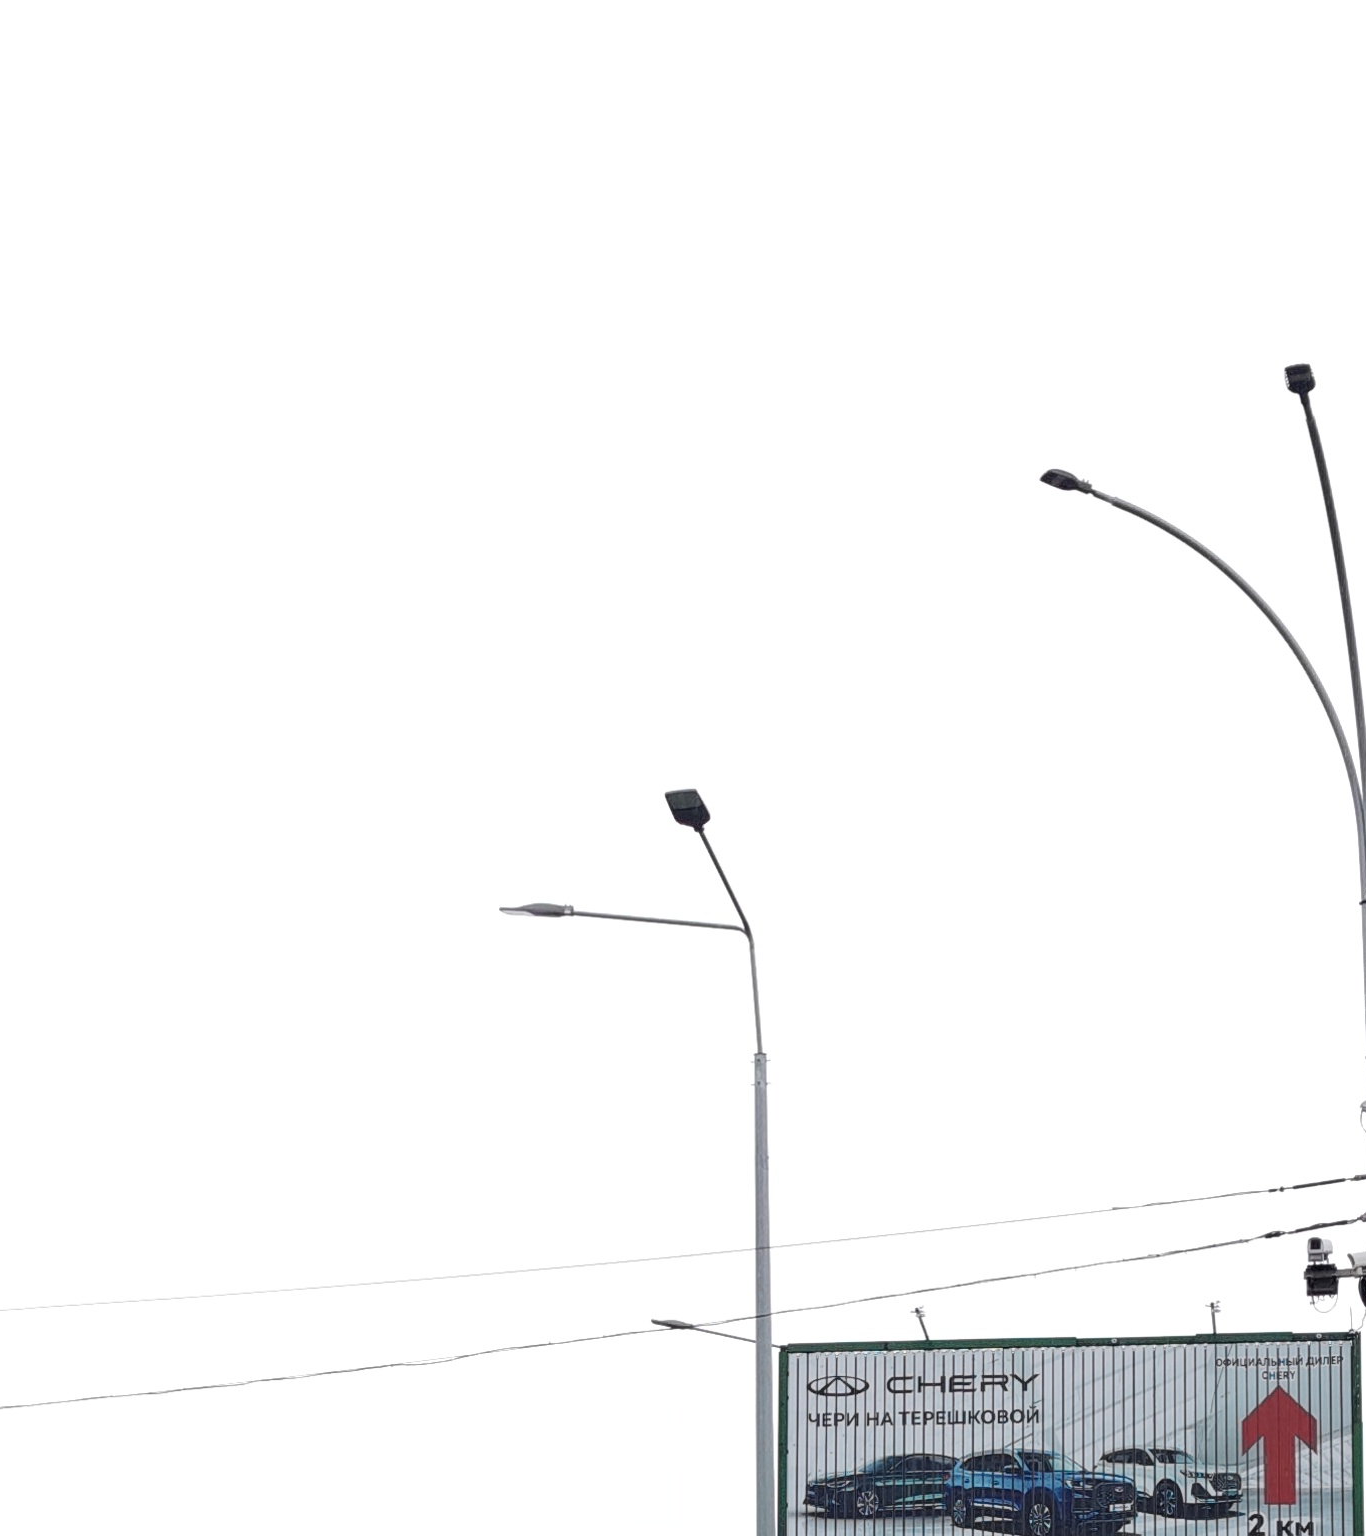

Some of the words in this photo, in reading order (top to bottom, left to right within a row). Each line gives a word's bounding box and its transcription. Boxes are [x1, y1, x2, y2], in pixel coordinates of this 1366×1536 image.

[1215, 1356, 1303, 1368] ОФИЦИАЛЬНЫЙ
[1306, 1355, 1344, 1367] ДИЛЕР
[886, 1373, 1040, 1394] CHERY
[1261, 1371, 1296, 1380] CHERY
[808, 1412, 860, 1427] ЧЕРИ
[866, 1412, 894, 1426] НА
[898, 1405, 1040, 1426] ТЕРЕШКОВОЙ
[1247, 1514, 1266, 1536] 2
